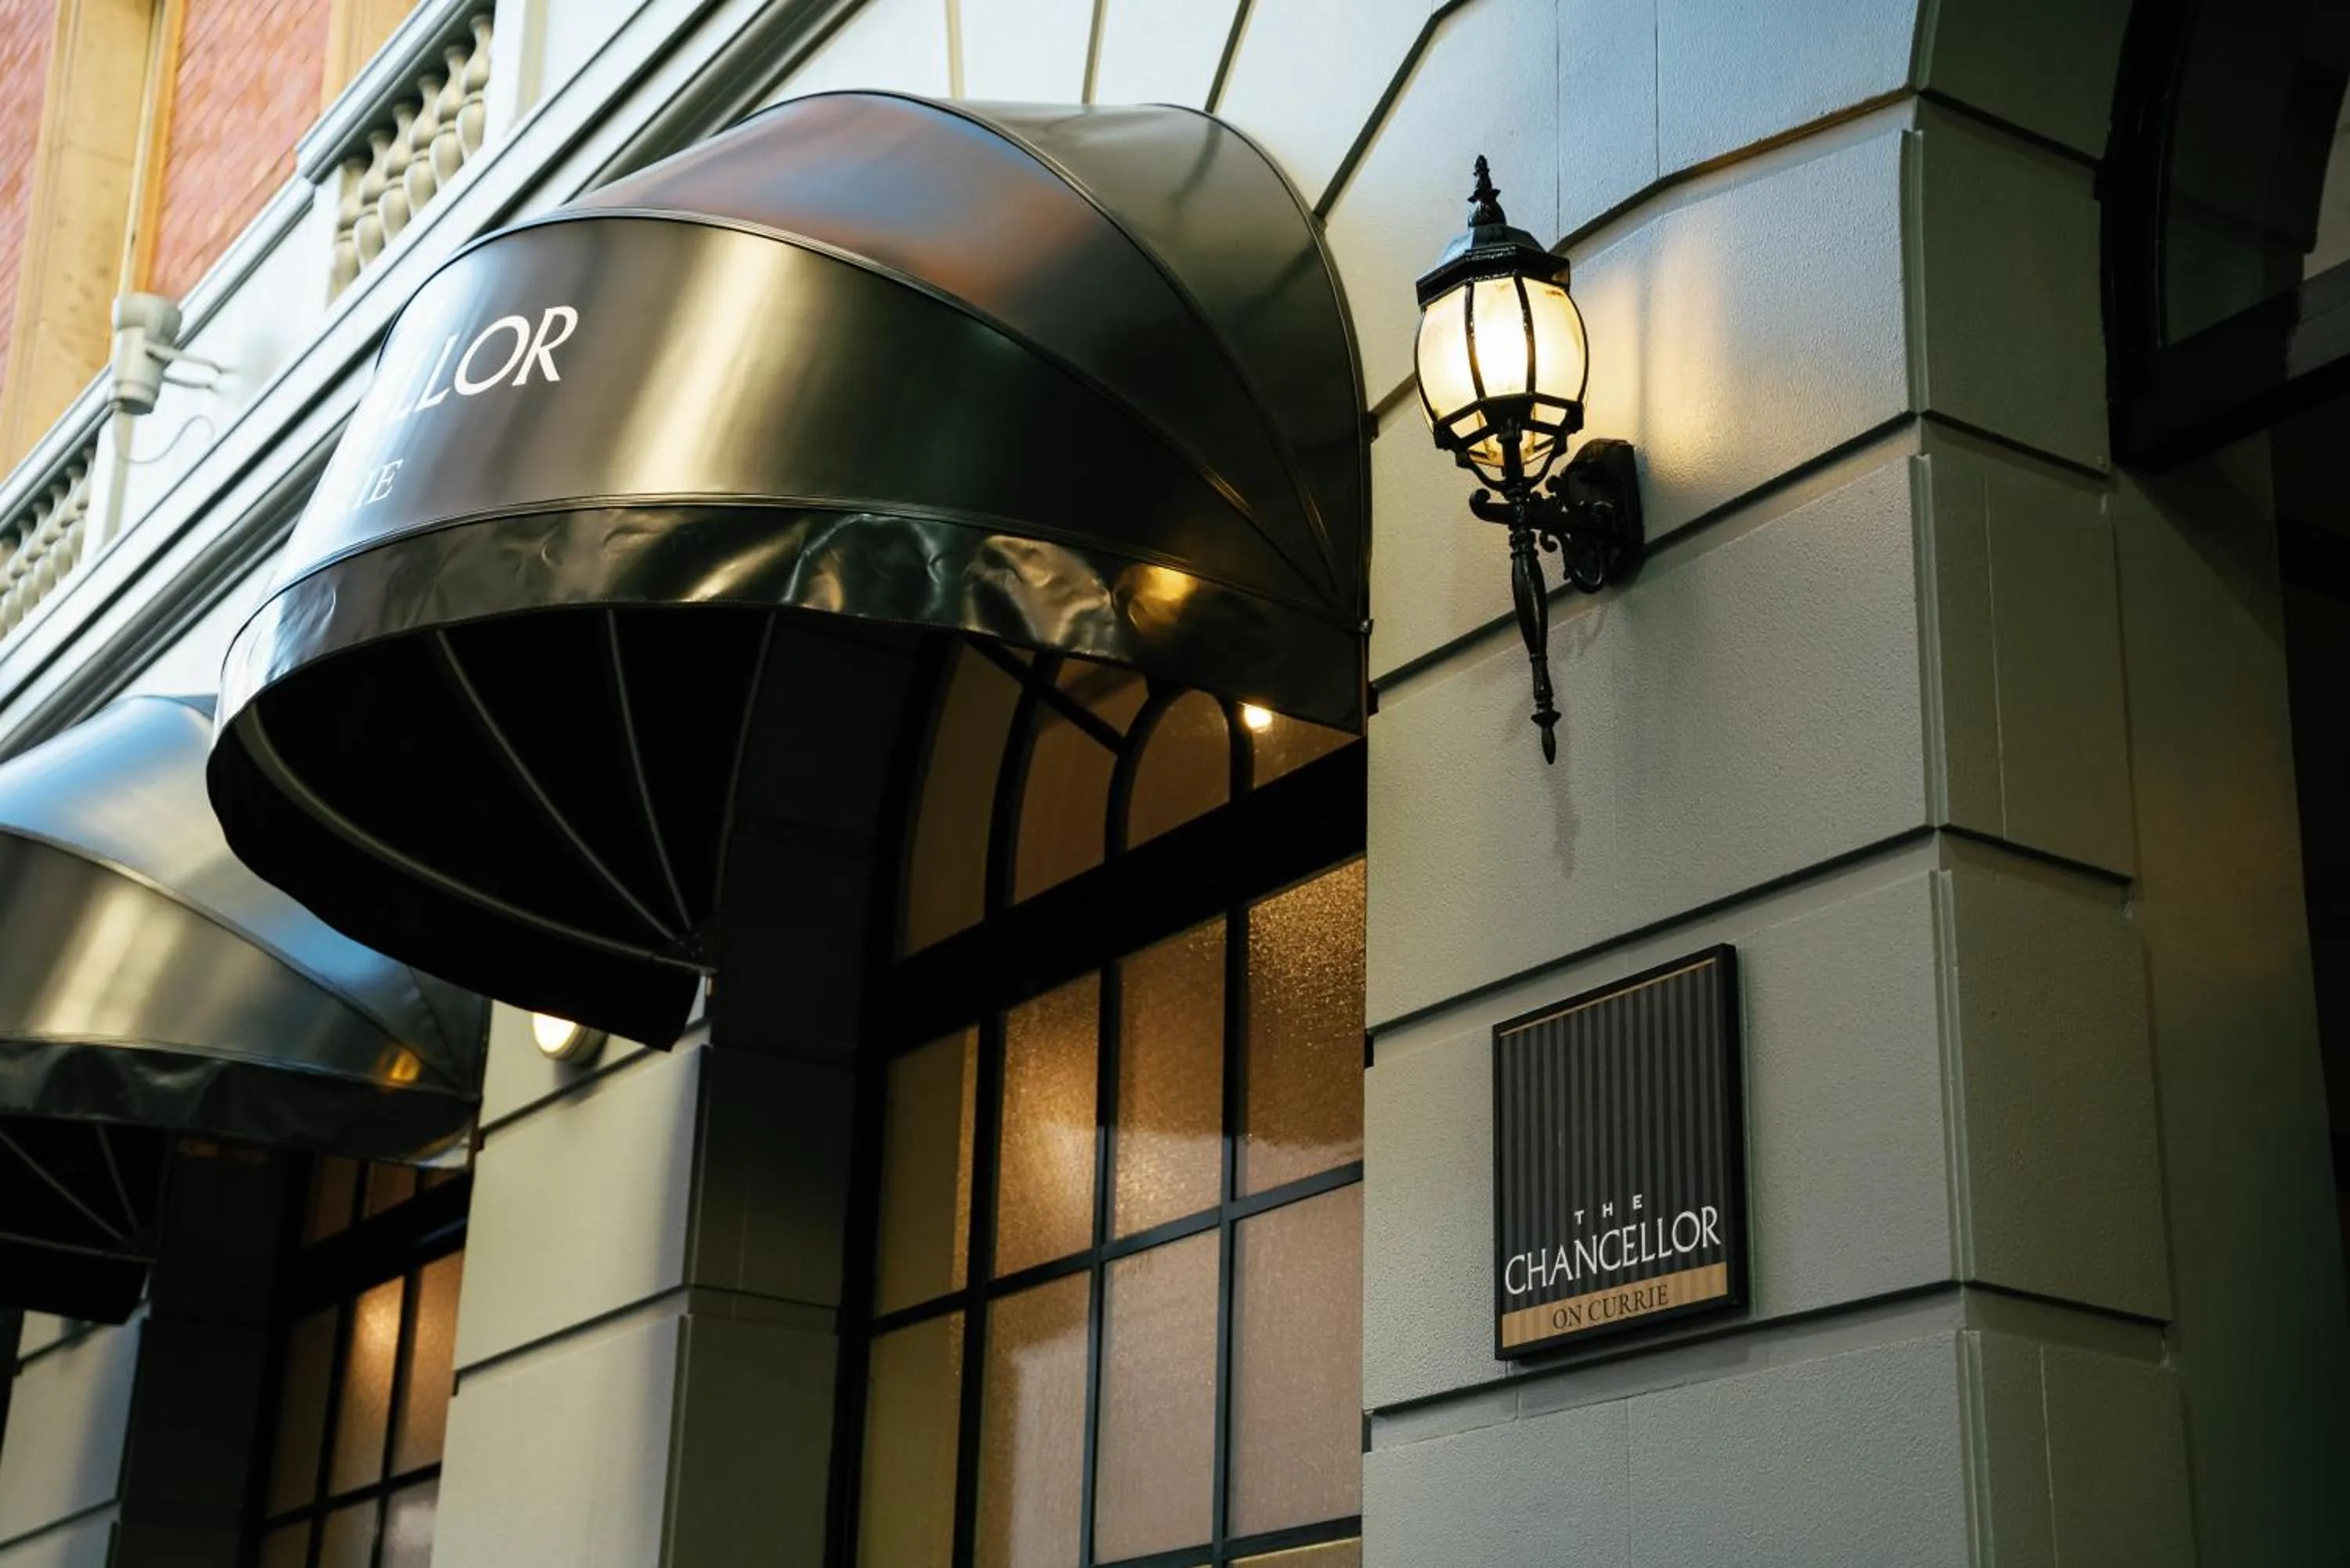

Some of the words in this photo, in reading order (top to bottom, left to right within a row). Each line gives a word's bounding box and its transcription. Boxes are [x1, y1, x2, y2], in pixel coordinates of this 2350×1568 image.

[1574, 1194, 1643, 1224] THE
[1504, 1205, 1721, 1295] CHANCELLOR
[1552, 1304, 1582, 1330] ON
[1588, 1284, 1669, 1321] CURRIE
